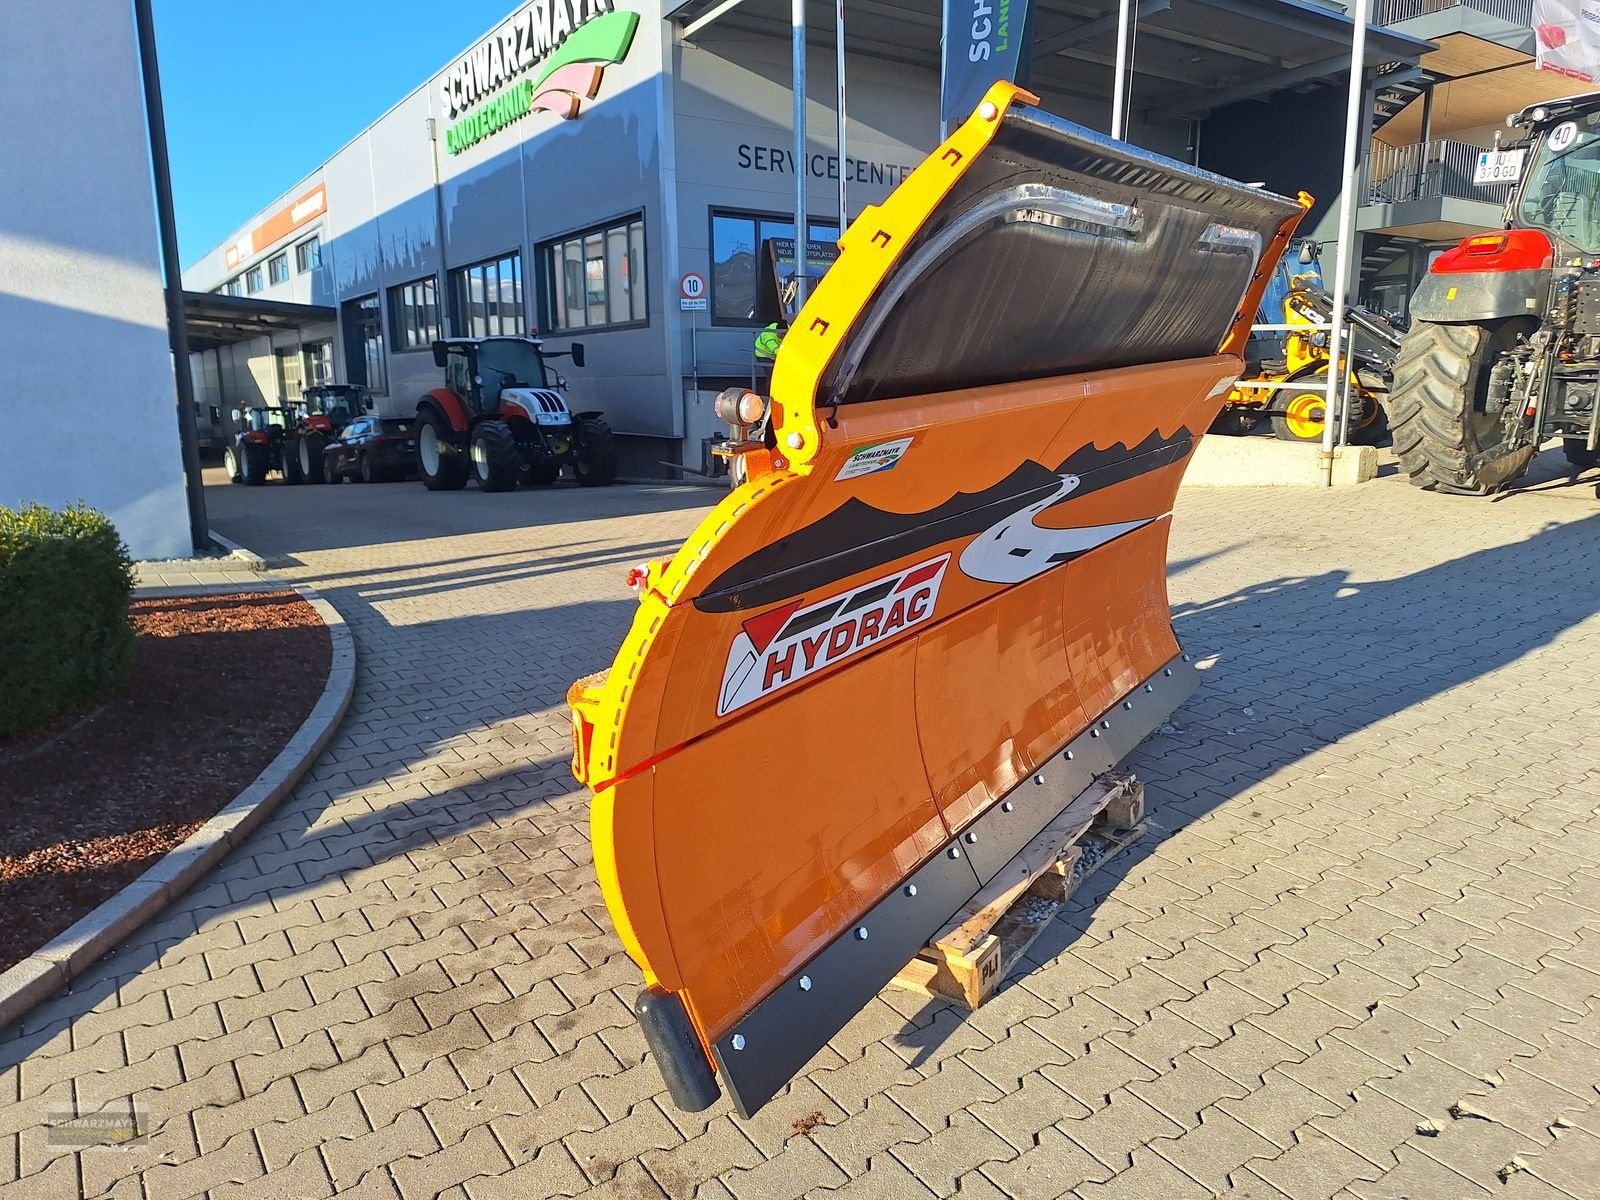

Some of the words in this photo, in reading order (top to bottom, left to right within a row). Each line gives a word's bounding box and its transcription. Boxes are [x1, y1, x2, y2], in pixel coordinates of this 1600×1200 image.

[445, 79, 531, 154] LANDTECHNIK
[1554, 127, 1571, 145] 40
[738, 144, 917, 187] SERICECENTE
[687, 279, 698, 293] 10
[1300, 306, 1326, 325] JCB
[852, 447, 901, 462] SCHWARZMAYR
[762, 587, 931, 692] HYDRAC
